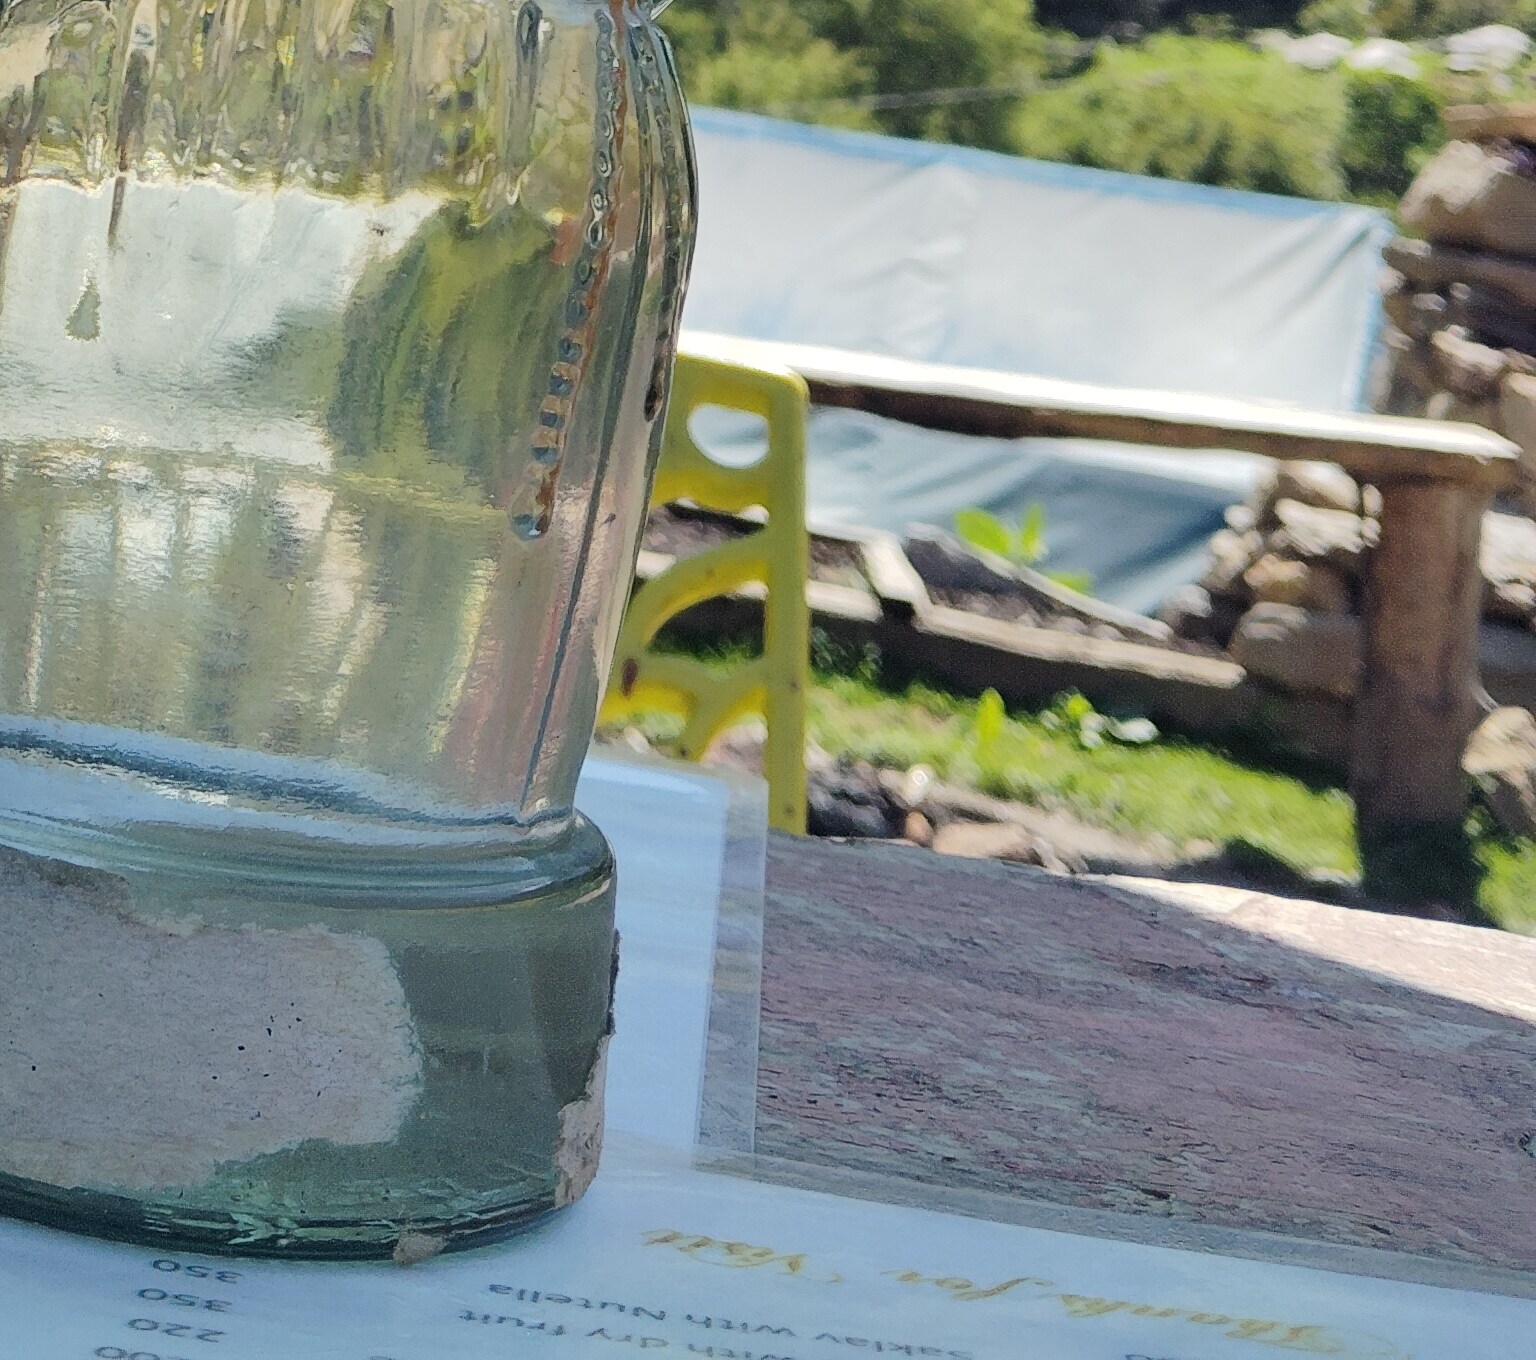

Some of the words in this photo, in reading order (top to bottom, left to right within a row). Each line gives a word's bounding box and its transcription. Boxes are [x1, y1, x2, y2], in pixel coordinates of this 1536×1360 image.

[151, 1259, 243, 1285] 350
[137, 1288, 232, 1313] 350
[488, 1283, 667, 1322] Nutella
[127, 1318, 224, 1343] 220
[458, 1310, 566, 1337] fruit
[686, 1314, 796, 1338] with
[585, 1328, 668, 1348] dry
